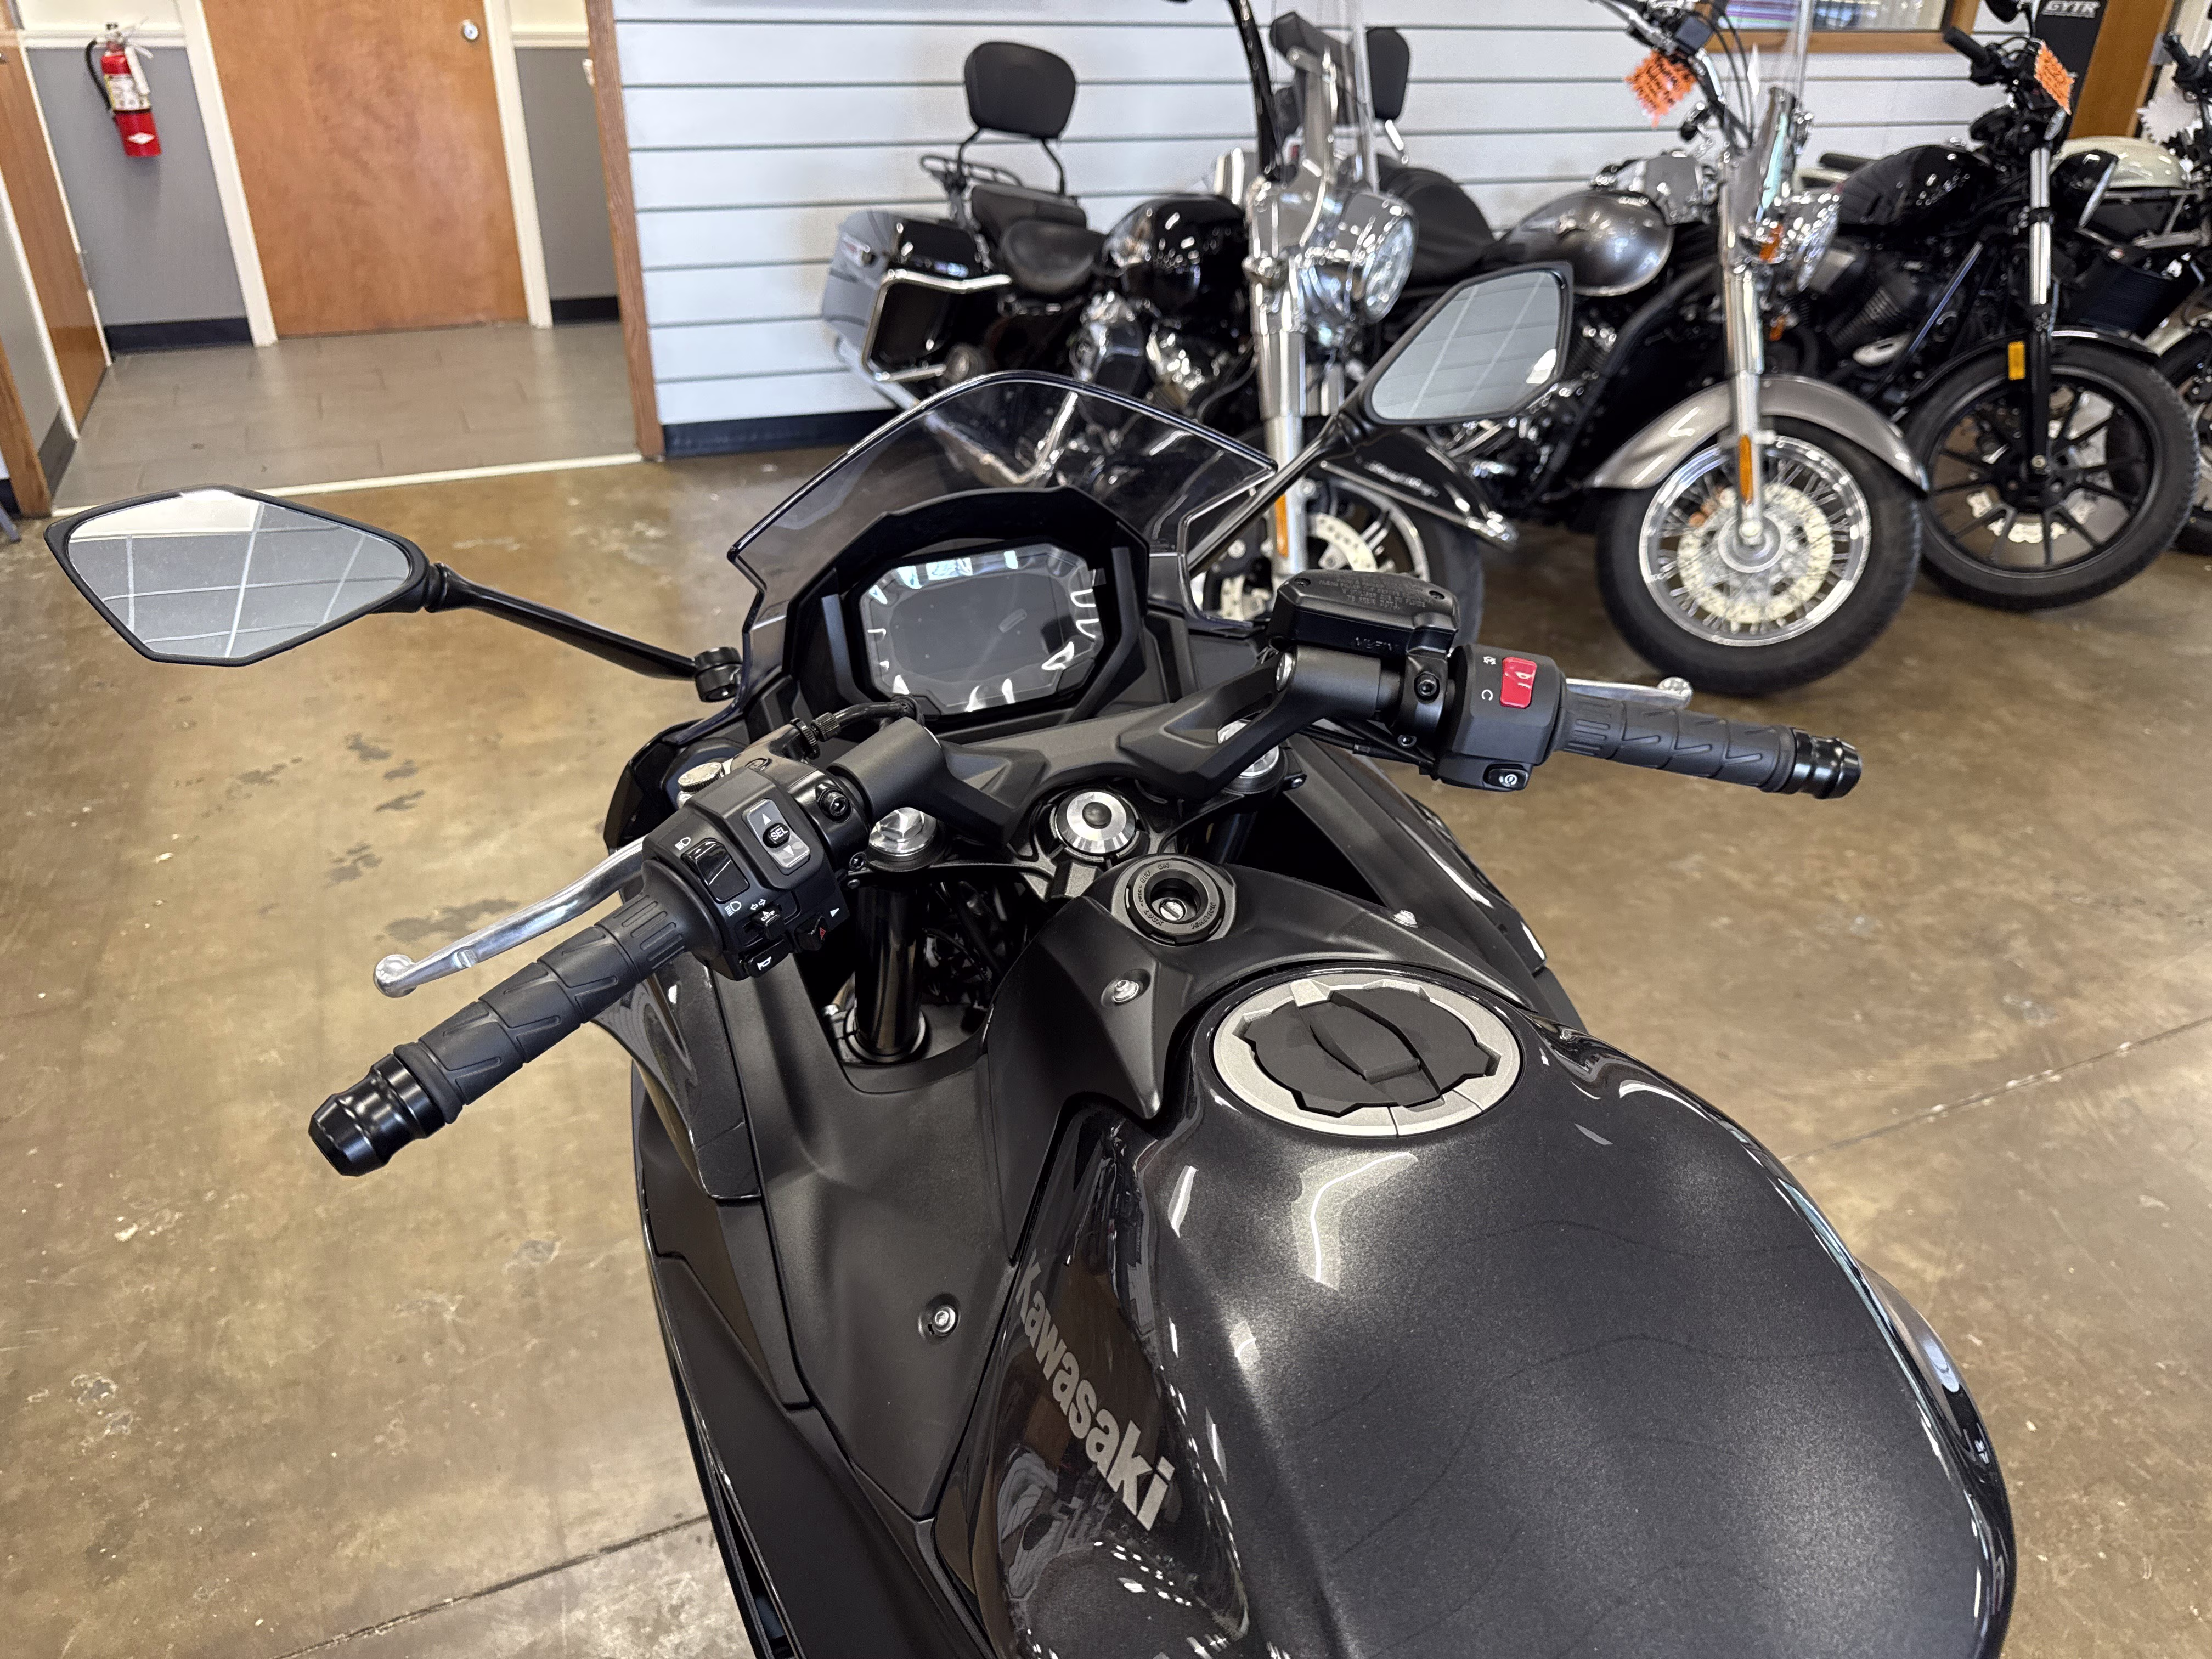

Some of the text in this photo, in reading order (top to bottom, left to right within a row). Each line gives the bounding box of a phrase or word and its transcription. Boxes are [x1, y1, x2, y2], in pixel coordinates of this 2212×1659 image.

[2045, 0, 2101, 13] GYTR
[771, 827, 788, 840] SEL
[1140, 870, 1151, 883] OFF
[760, 910, 776, 921] OFF
[1144, 909, 1164, 926] LOCK
[1190, 901, 1216, 929] IGNITION
[1015, 1247, 1175, 1531] Kawasaki
